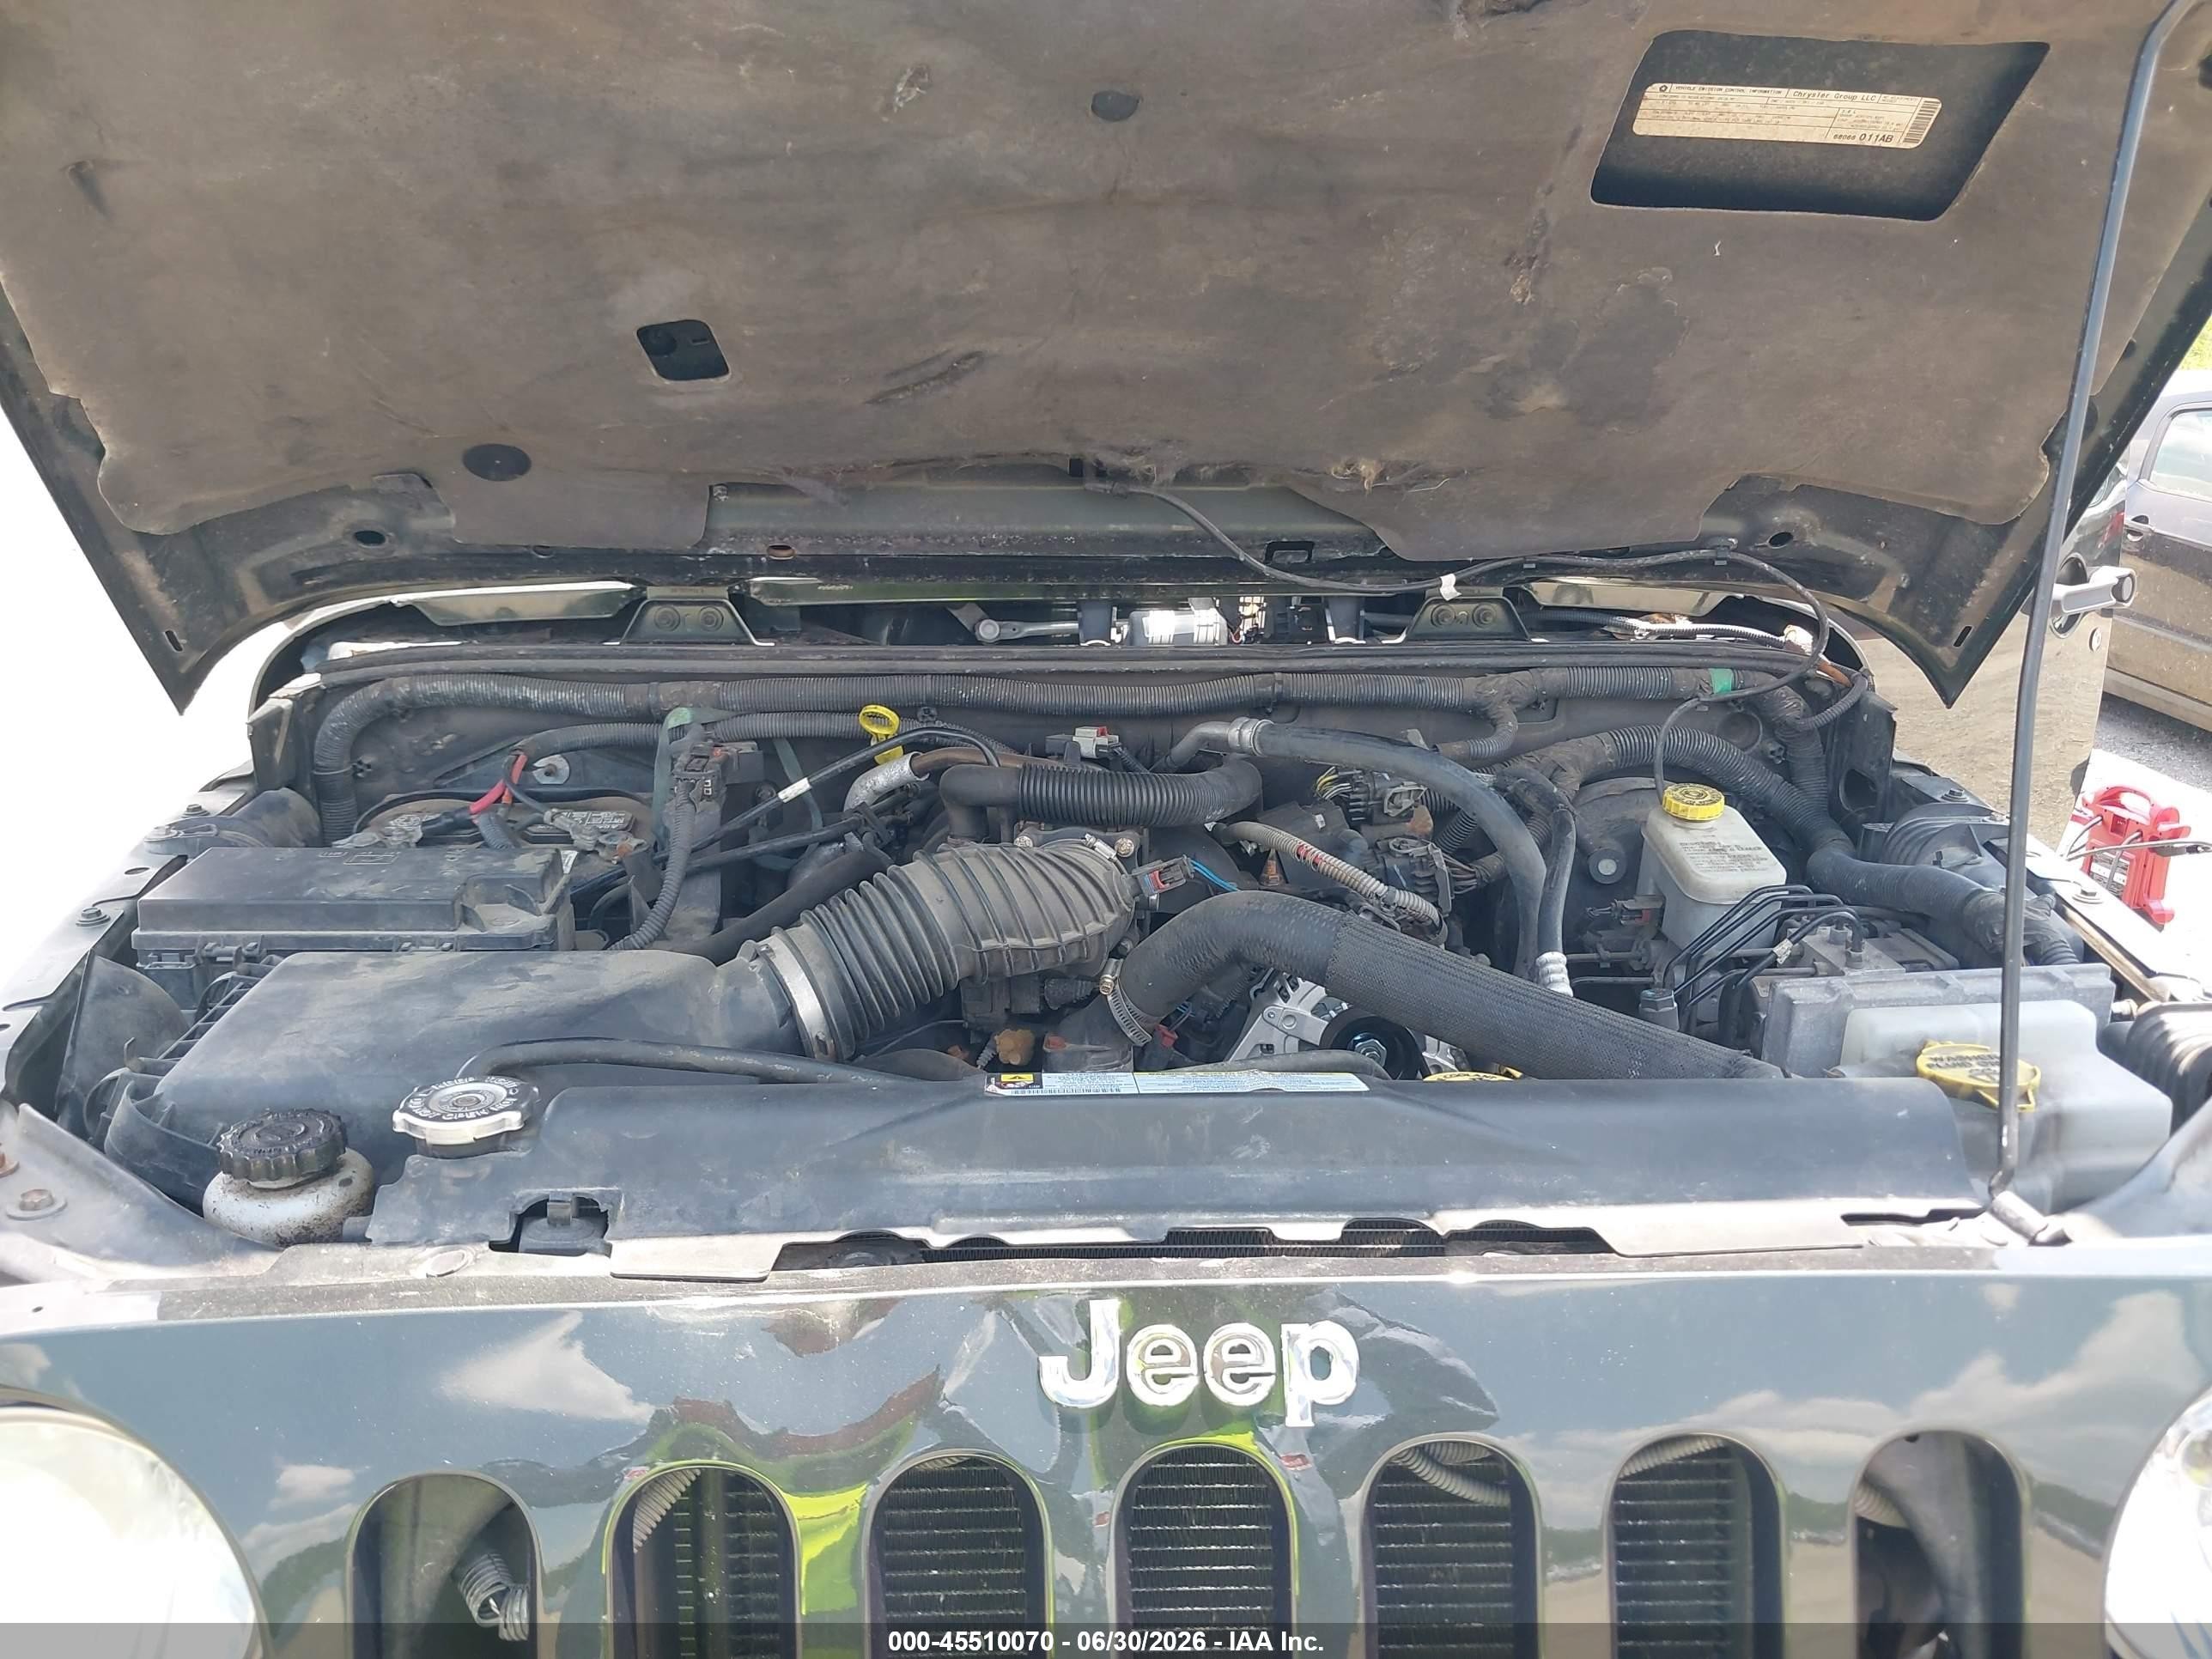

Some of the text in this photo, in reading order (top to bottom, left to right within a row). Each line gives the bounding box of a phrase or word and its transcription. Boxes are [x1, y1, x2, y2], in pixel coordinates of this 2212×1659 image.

[1792, 90, 1830, 99] Chrysler
[1859, 132, 1894, 143] 011AB
[1039, 1299, 1360, 1427] Jeep
